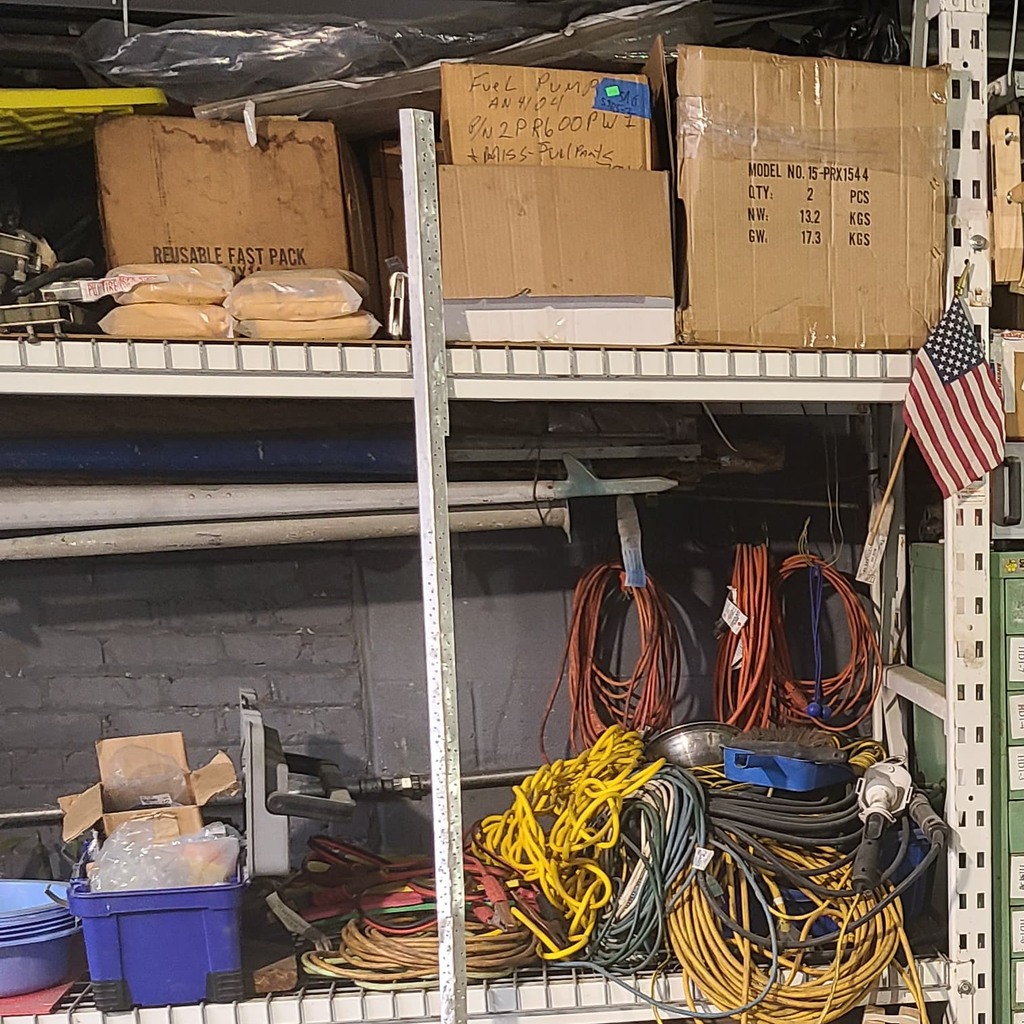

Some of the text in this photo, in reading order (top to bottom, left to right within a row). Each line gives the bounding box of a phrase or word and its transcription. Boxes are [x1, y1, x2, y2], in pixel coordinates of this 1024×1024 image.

[748, 162, 869, 182] MODEL NO. 15-PRX1544
[748, 185, 870, 204] QTY: 2 PCS
[747, 207, 871, 226] NW: 13.2 KGS
[801, 230, 822, 245] 17.3
[848, 232, 871, 246] KGS
[153, 246, 306, 266] REUSABLE FAST PACK
